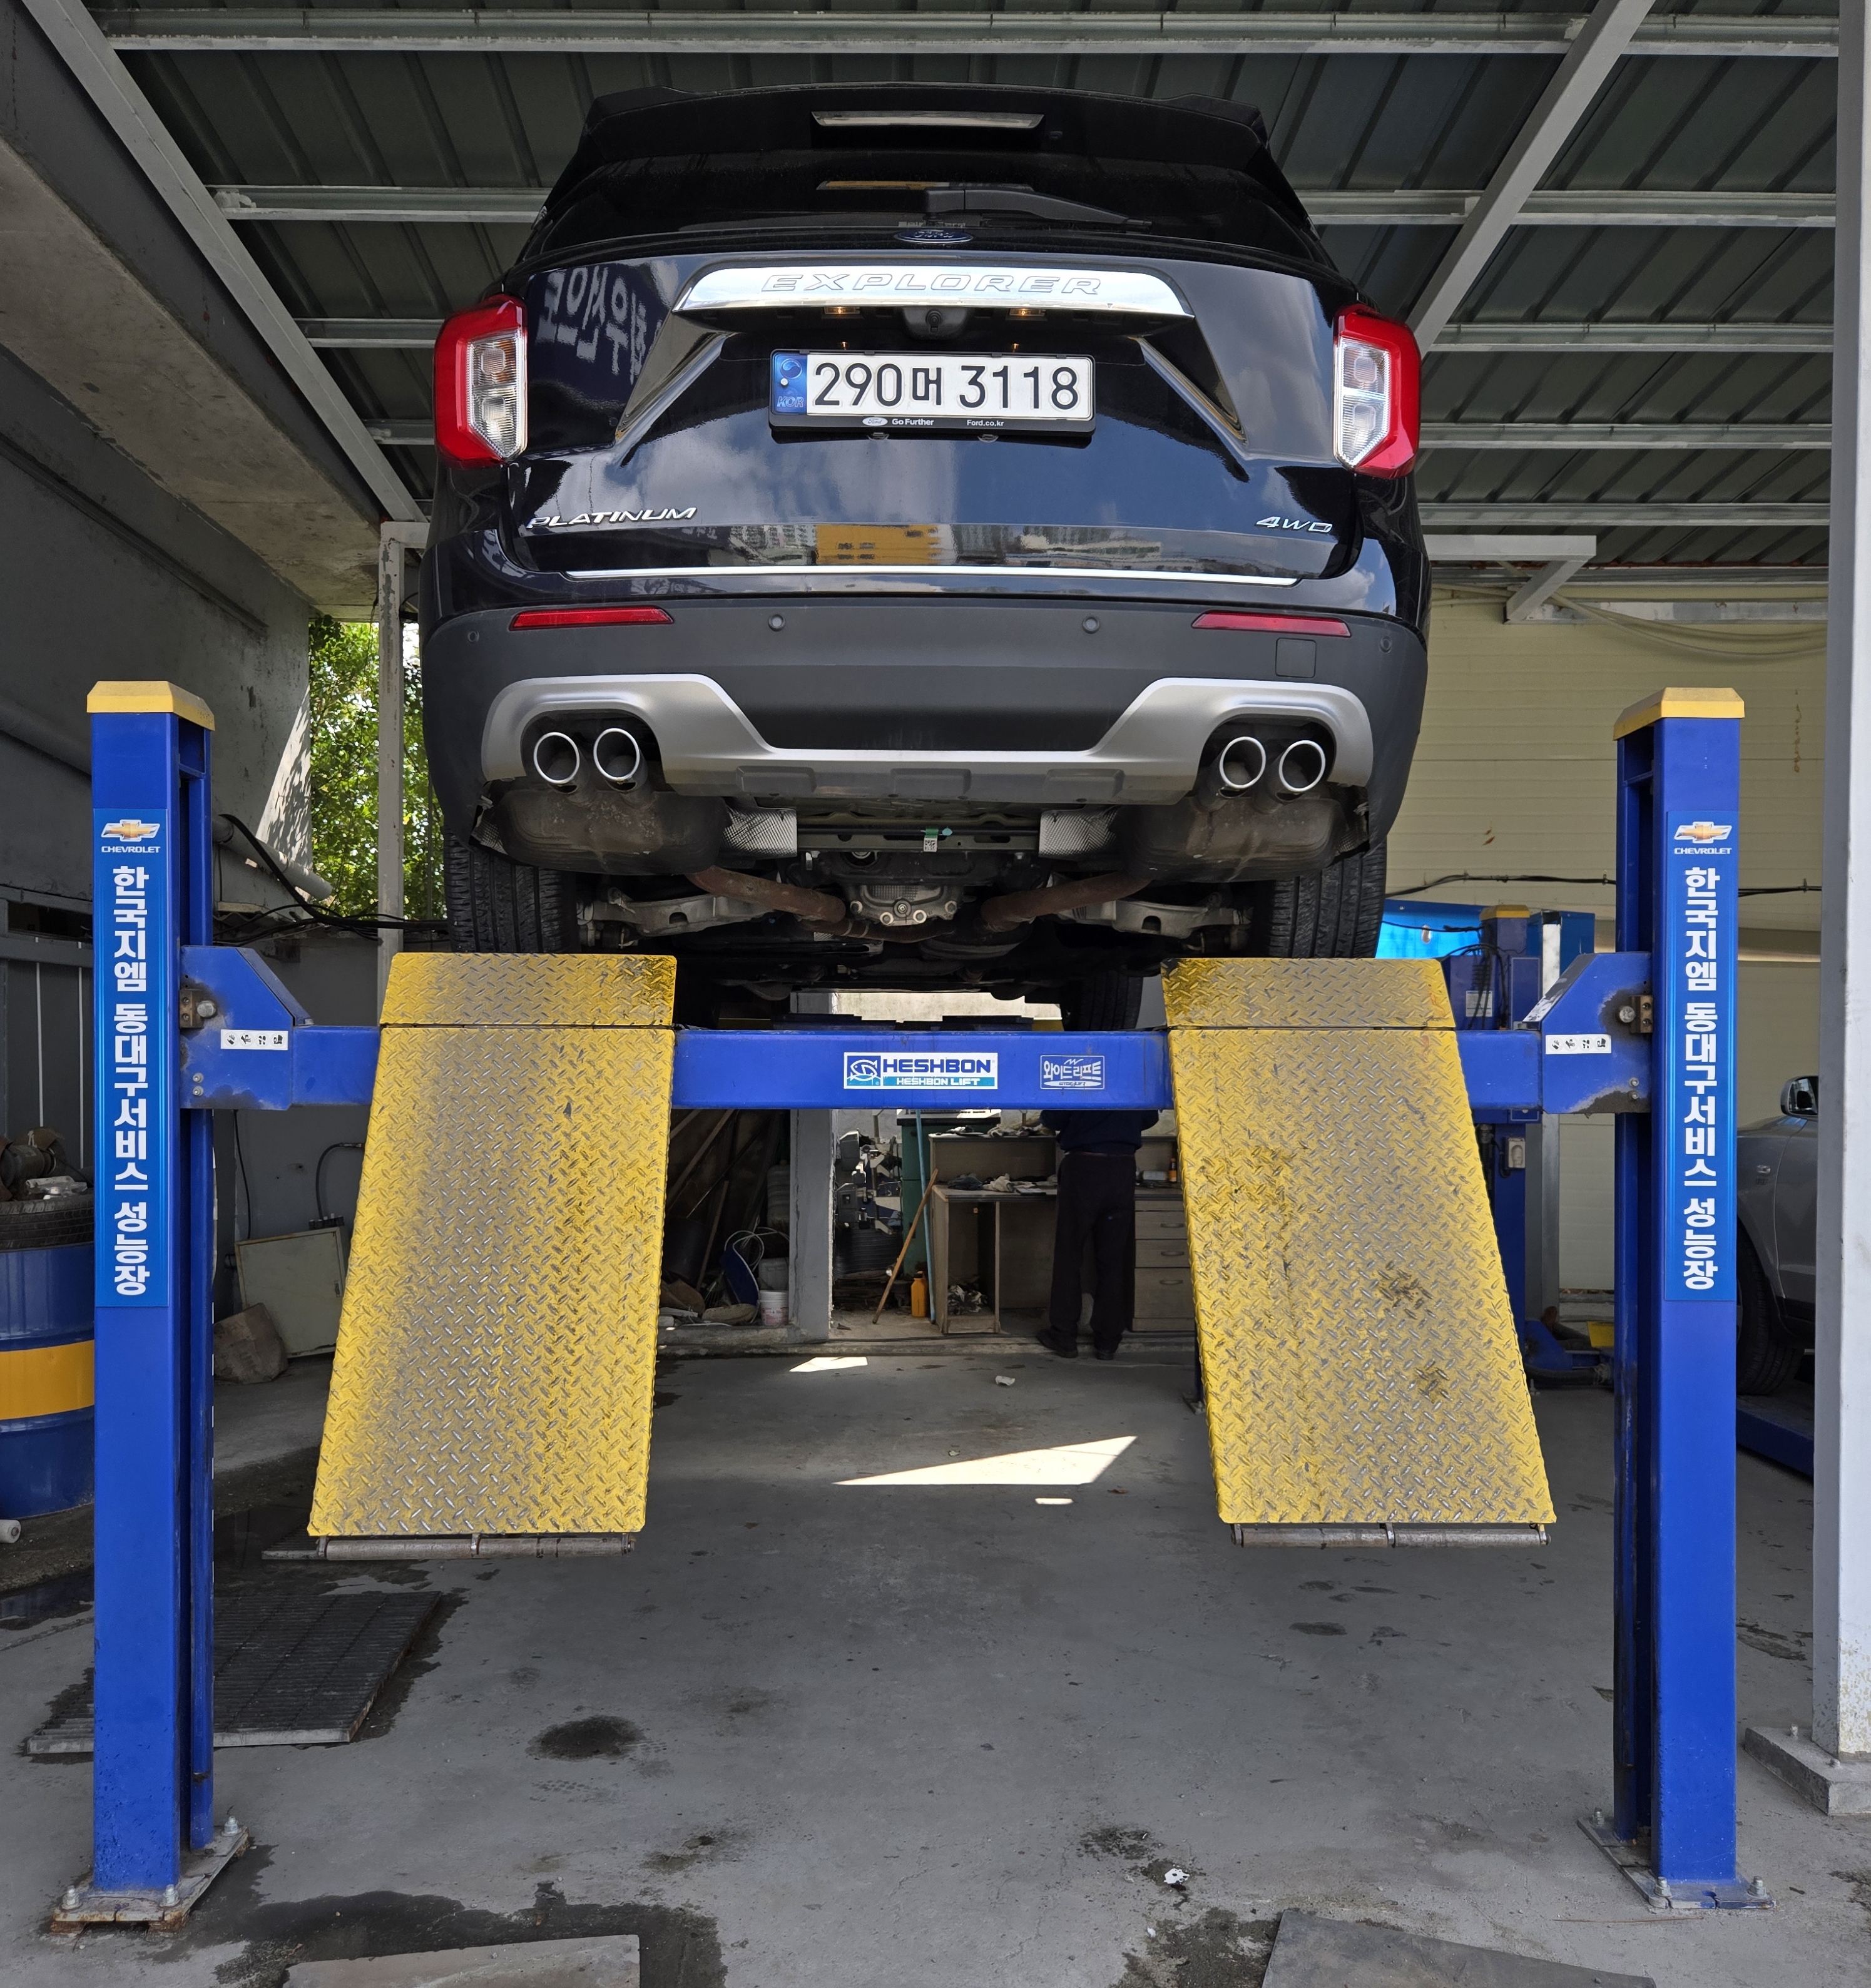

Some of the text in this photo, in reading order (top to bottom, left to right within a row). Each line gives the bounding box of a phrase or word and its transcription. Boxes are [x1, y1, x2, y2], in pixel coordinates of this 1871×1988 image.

[761, 273, 1101, 295] EXPLORER
[815, 363, 1078, 410] 290머 3118
[777, 396, 803, 407] KOR
[526, 507, 696, 529] PLATINUM
[1256, 516, 1333, 533] 4WD
[883, 1059, 991, 1073] HESHBON
[1043, 1061, 1102, 1081] 와이드리프트
[113, 866, 150, 1296] 한국지엠 동대구서비스 성능장
[896, 1078, 981, 1086] HESHBON LIFT
[1683, 867, 1720, 1290] 한국지엠 동대구서비스 성능장
